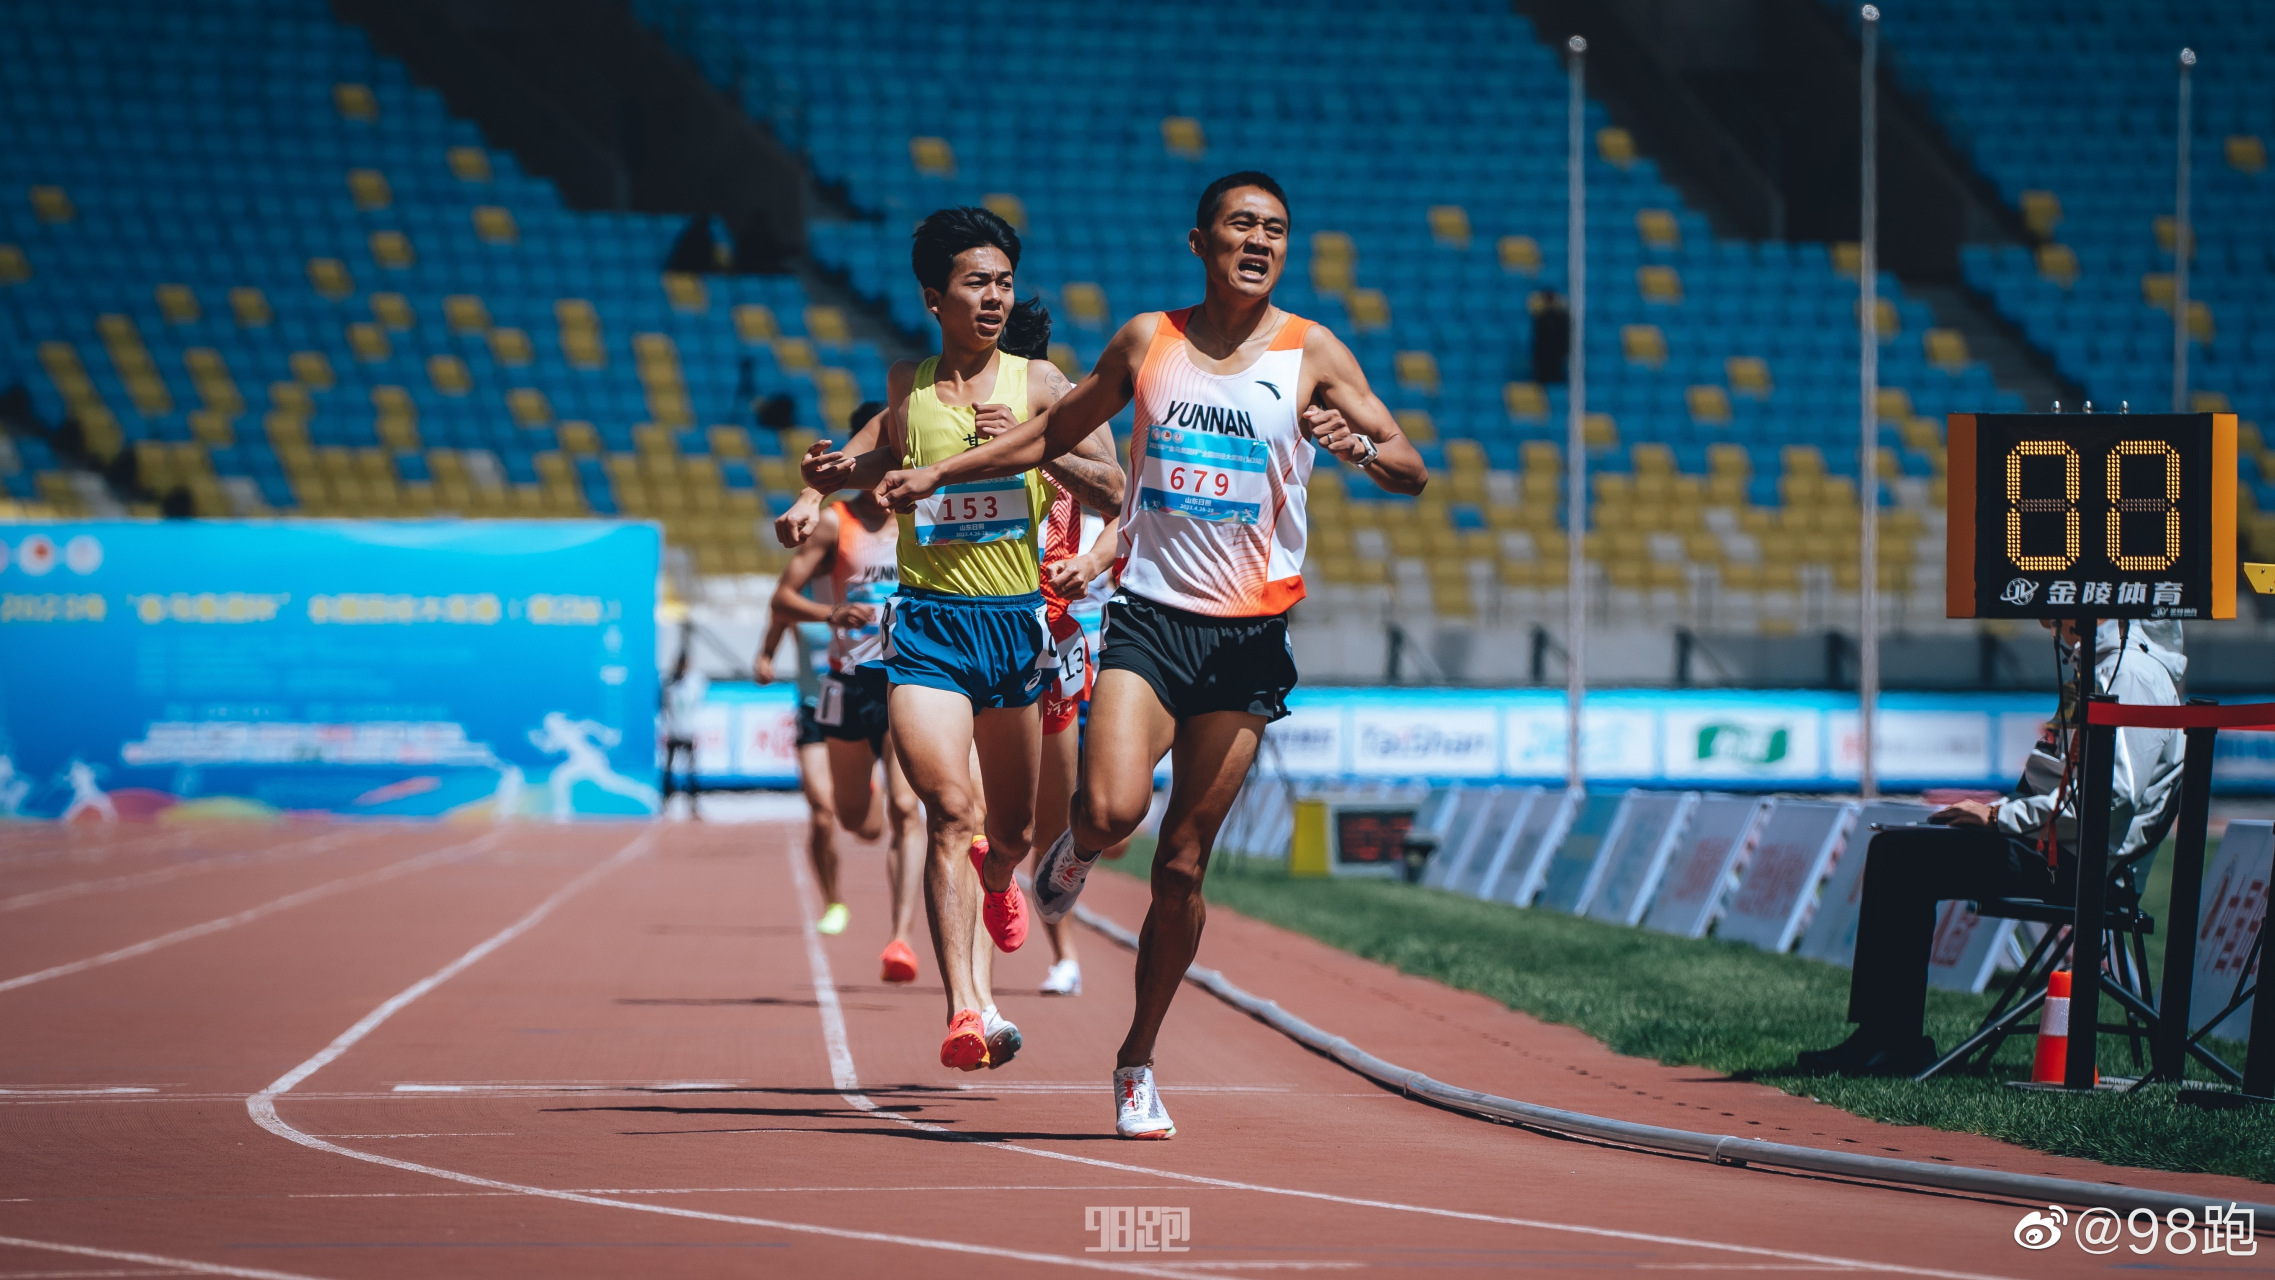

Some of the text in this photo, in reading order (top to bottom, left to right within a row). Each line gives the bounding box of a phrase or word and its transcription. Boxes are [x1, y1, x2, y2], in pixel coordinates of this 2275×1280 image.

[1162, 400, 1256, 438] YUNNAN
[1170, 466, 1229, 496] 679
[943, 496, 998, 520] 153
[2046, 580, 2184, 606] 金陵体育
[1061, 646, 1084, 682] 13
